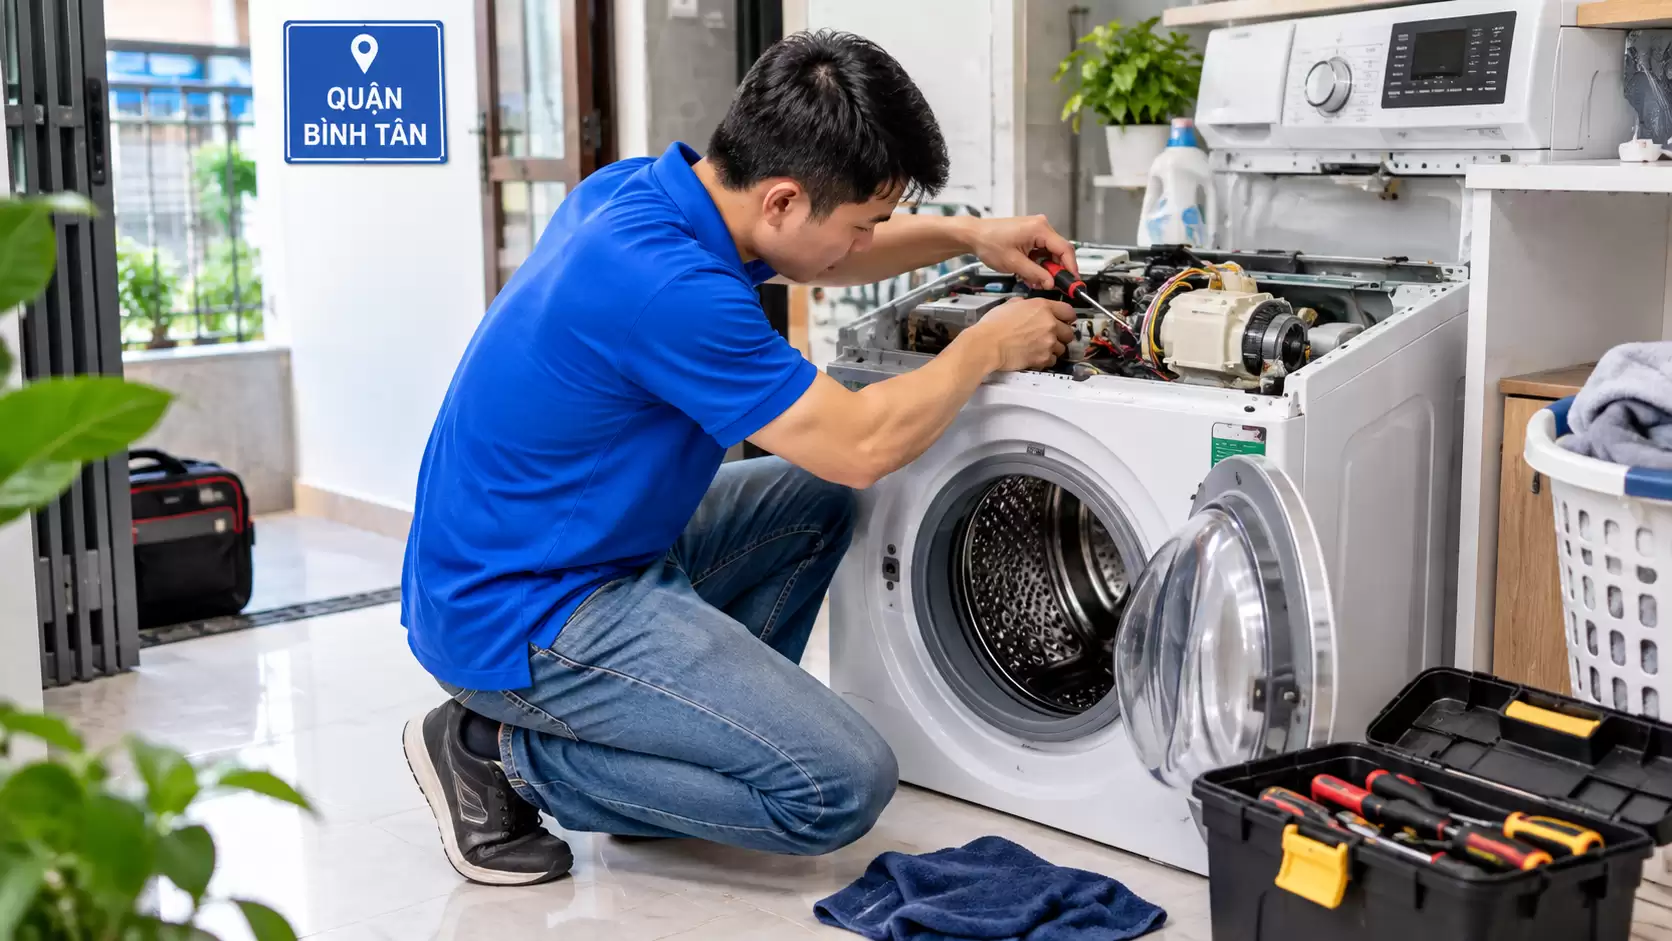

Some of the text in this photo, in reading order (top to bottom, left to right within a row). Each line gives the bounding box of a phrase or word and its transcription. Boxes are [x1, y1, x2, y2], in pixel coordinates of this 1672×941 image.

[327, 81, 402, 116] QUẬN
[303, 117, 427, 146] BÌNH TÂN
